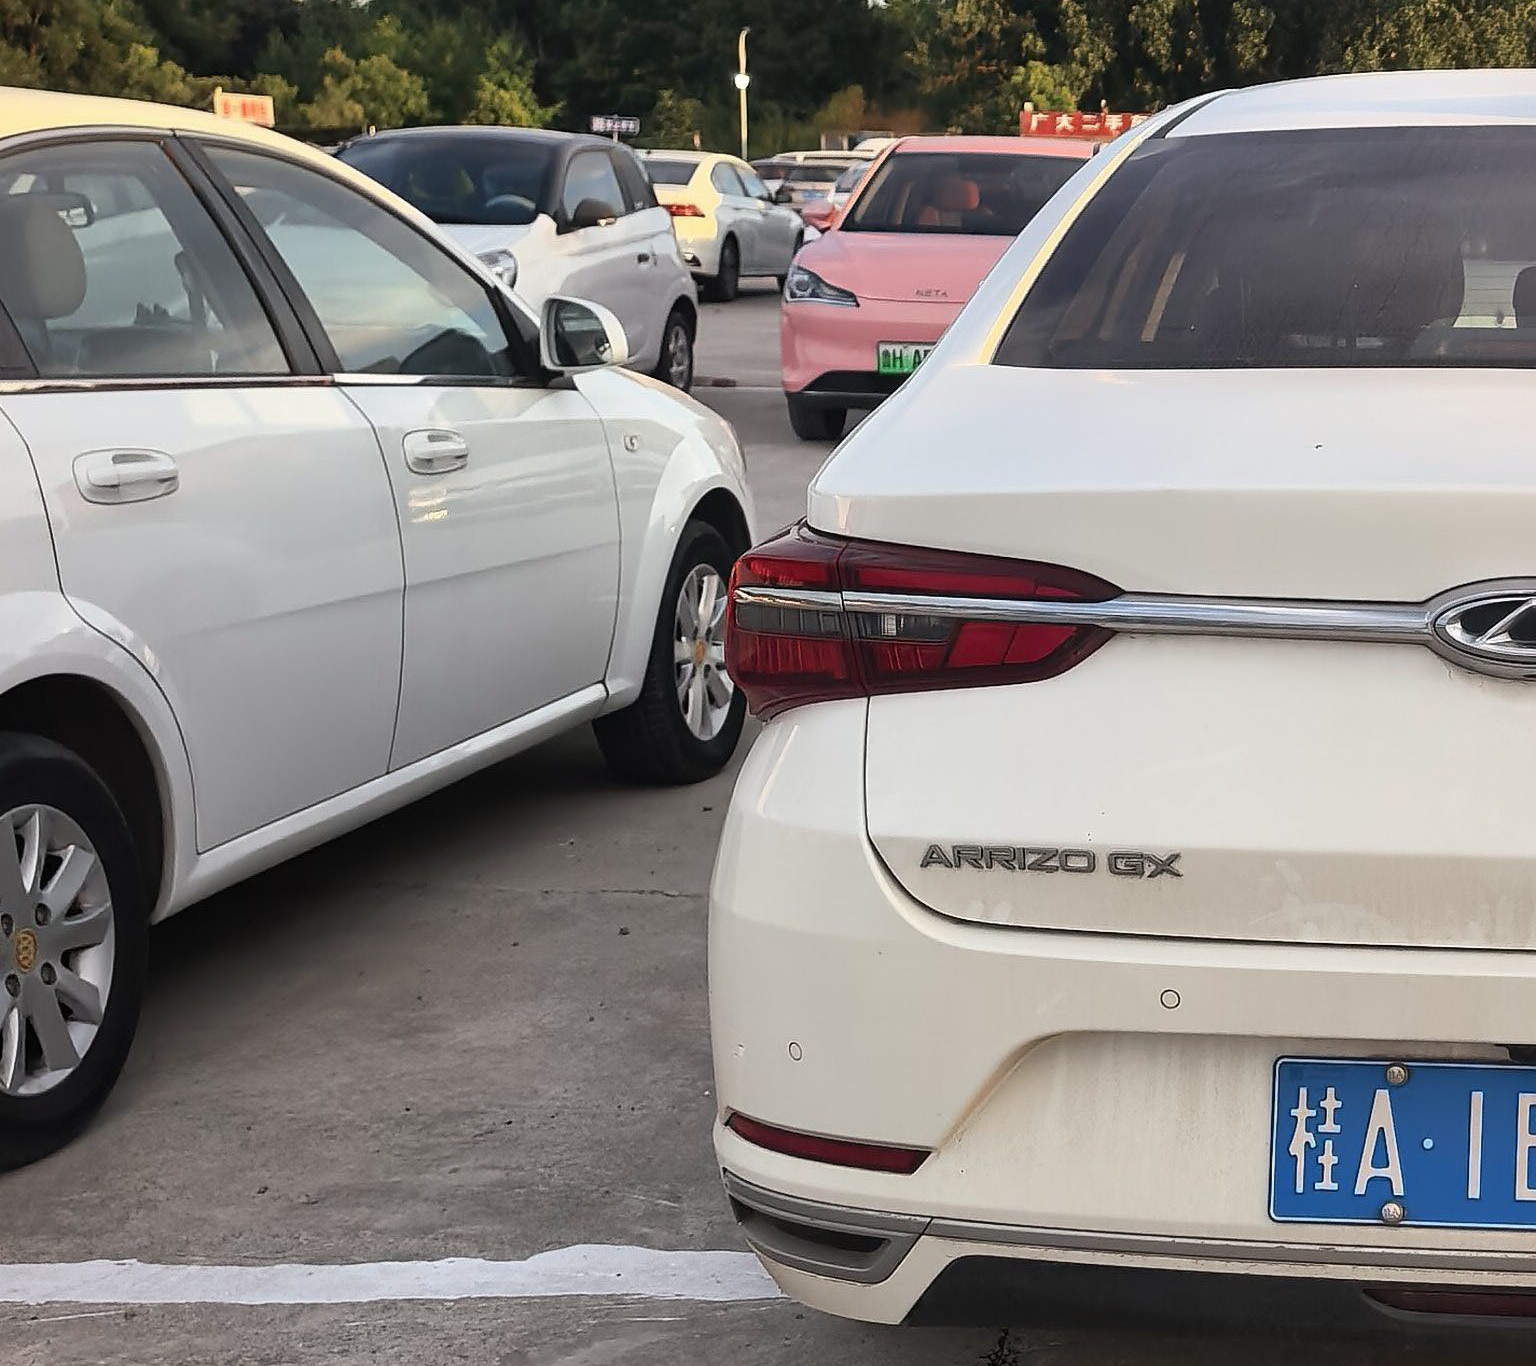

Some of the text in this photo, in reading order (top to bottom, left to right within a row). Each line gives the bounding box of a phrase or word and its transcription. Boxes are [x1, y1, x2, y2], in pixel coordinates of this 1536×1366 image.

[915, 289, 948, 298] NETA
[919, 843, 1184, 878] ARRIZO GX
